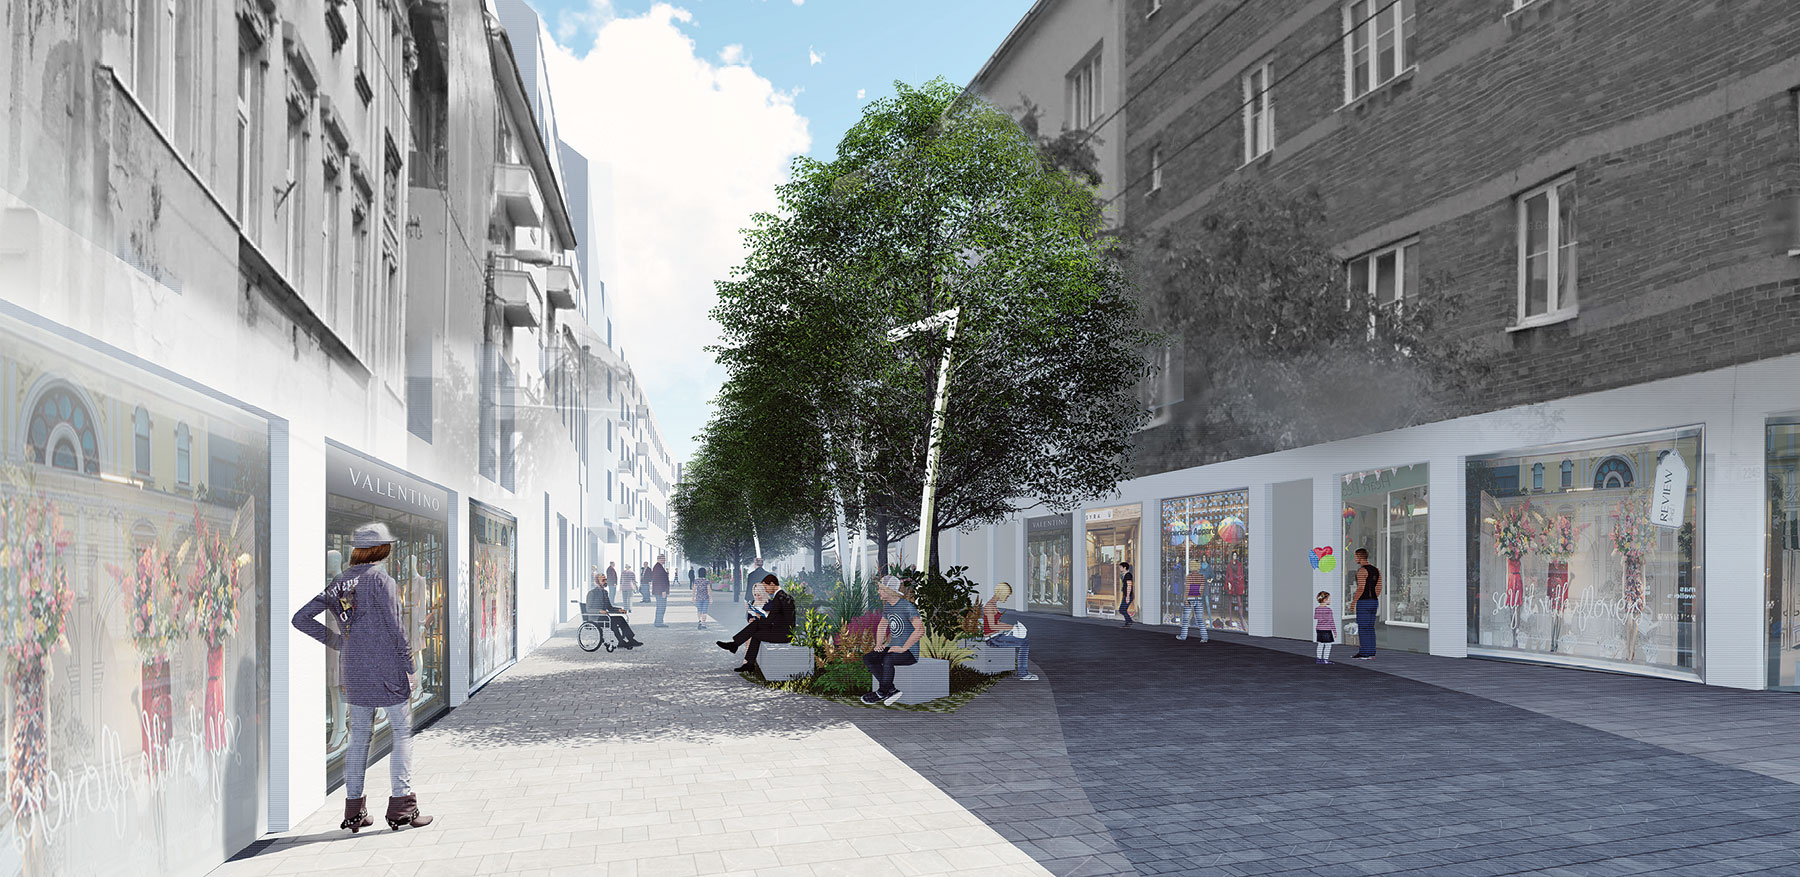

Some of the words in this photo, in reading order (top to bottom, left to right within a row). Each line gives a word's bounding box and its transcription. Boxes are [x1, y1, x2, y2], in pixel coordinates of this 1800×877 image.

[349, 467, 440, 511] VALENTINO
[1660, 469, 1673, 522] REVIEW
[1032, 519, 1068, 528] VALENTINO
[1193, 527, 1216, 536] Appare
[1493, 590, 1520, 629] say
[1525, 584, 1536, 614] it
[1539, 582, 1569, 618] with
[1575, 585, 1643, 631] flowers
